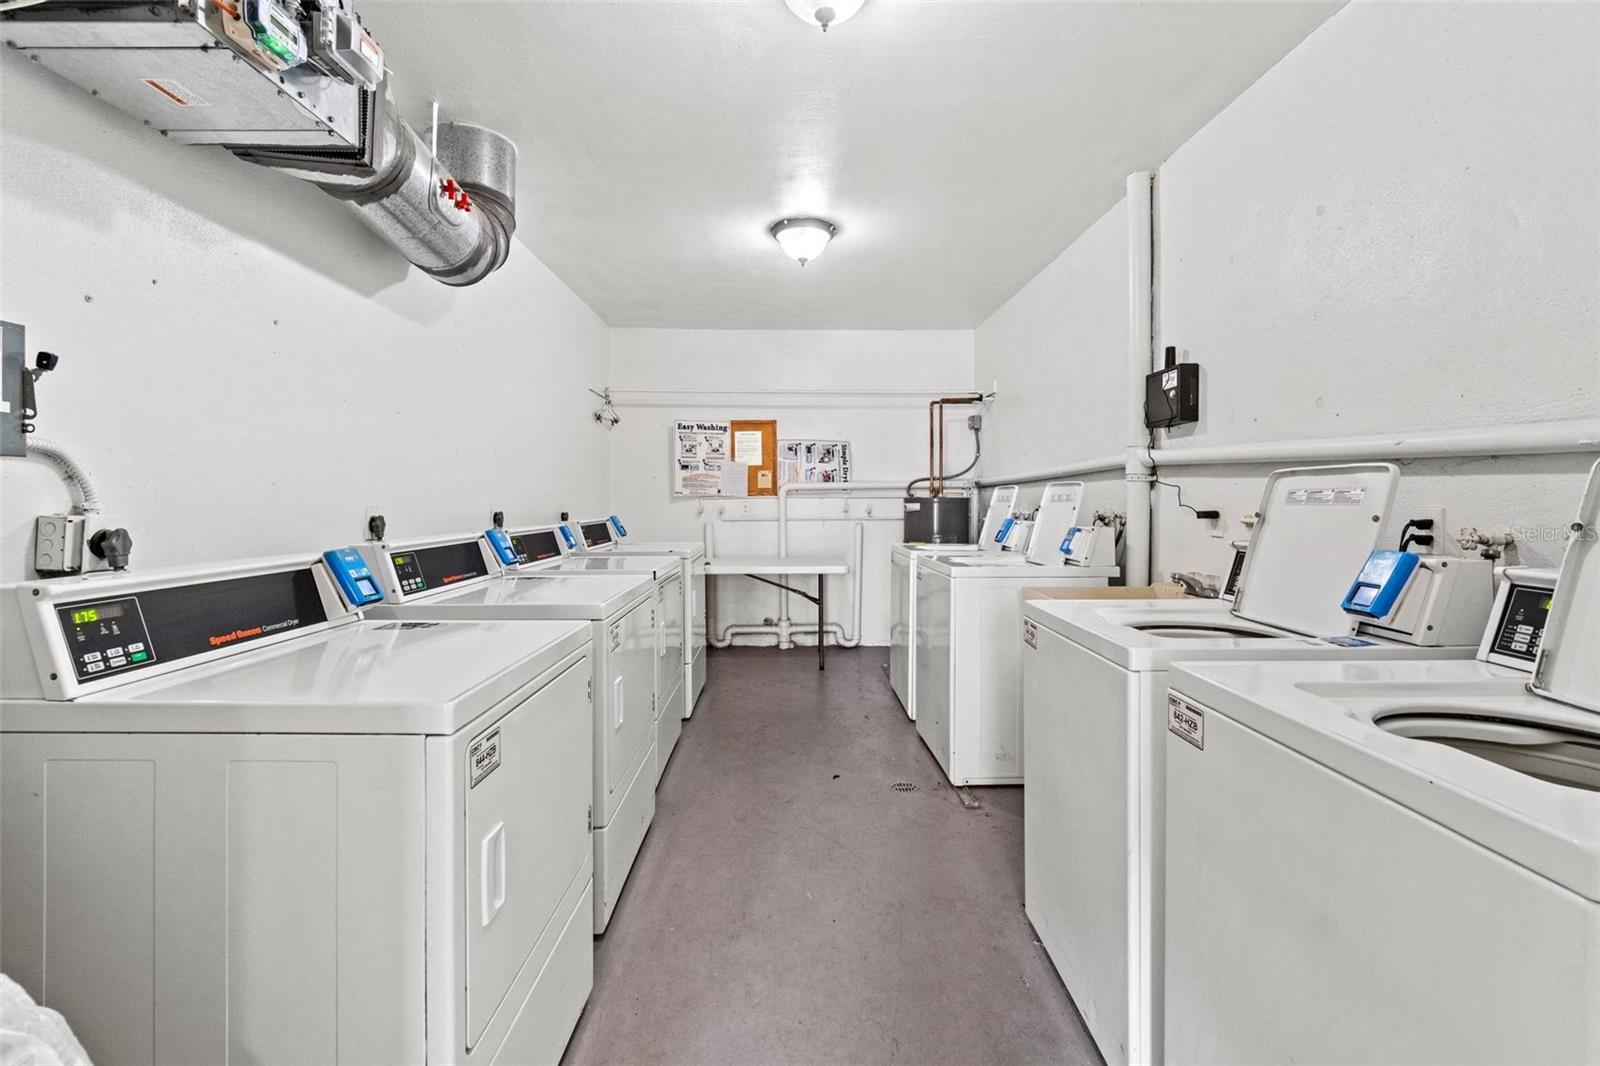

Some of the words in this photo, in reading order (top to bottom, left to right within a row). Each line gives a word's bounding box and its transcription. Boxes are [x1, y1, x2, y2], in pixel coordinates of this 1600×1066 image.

[677, 423, 695, 432] Easy
[696, 424, 729, 433] Washing
[840, 444, 849, 465] Simple
[209, 631, 237, 645] Speed
[236, 626, 262, 639] Queen
[262, 622, 288, 632] Commercial
